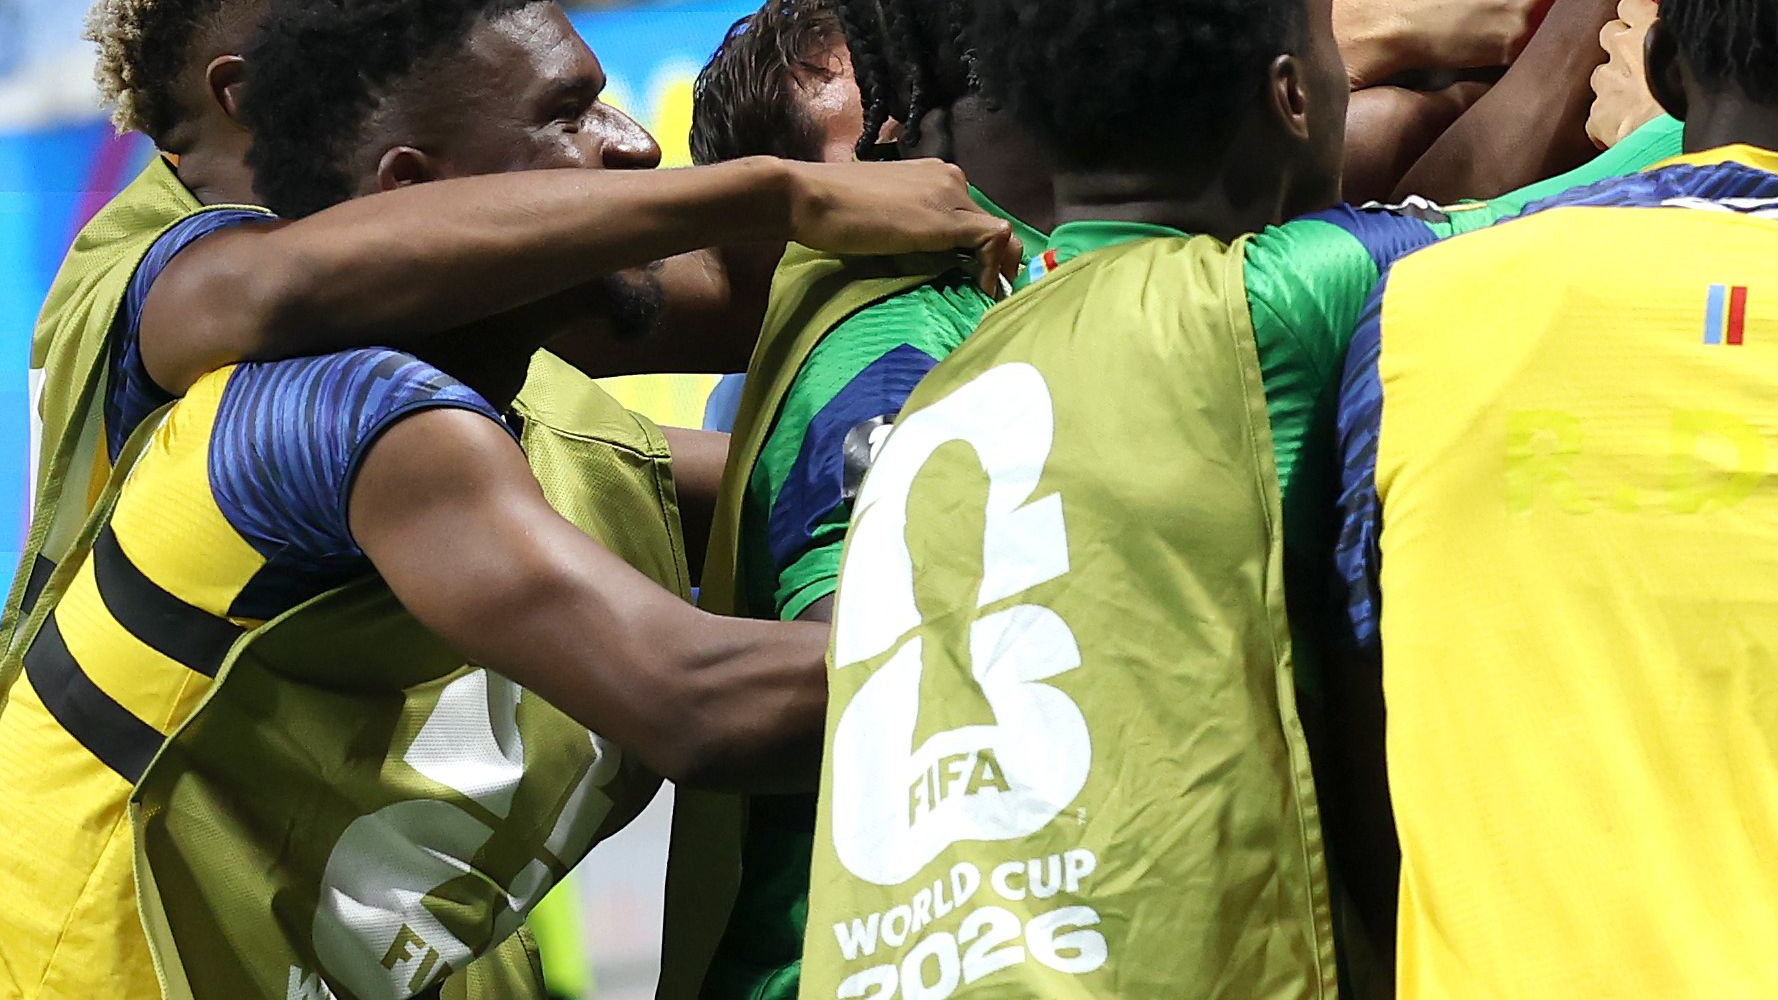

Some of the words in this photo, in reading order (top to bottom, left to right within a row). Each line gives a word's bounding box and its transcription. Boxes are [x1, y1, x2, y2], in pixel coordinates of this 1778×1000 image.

[908, 748, 1012, 829] FIFA
[832, 862, 981, 960] WORLD
[990, 848, 1097, 901] CUP
[381, 923, 453, 994] FI
